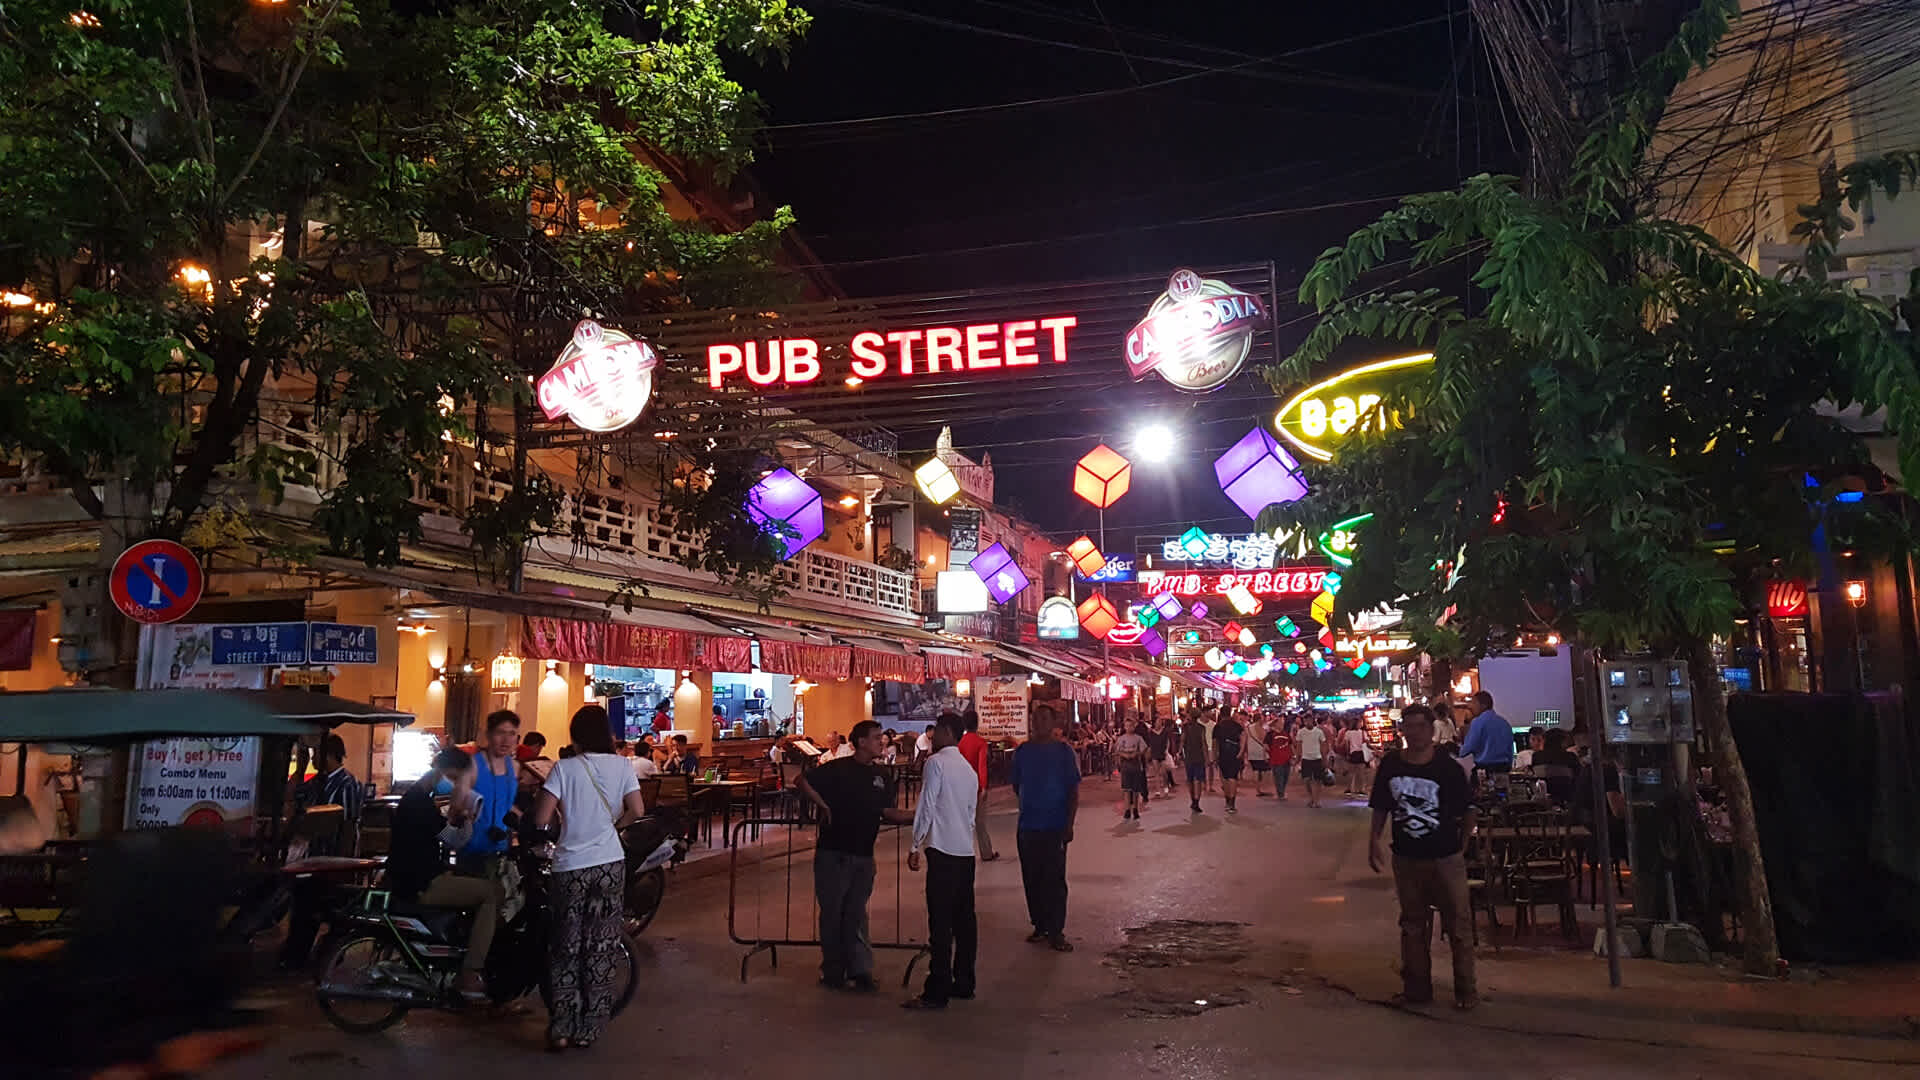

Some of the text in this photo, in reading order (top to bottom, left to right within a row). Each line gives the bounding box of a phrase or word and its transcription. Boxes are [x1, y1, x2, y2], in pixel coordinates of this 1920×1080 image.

[707, 316, 1078, 389] PUB STREET
[1147, 572, 1327, 595] PUB STREET
[1768, 583, 1806, 612] illy
[227, 651, 258, 664] STREET
[146, 748, 168, 763] Buy
[184, 749, 204, 763] get
[217, 750, 243, 761] Free
[160, 767, 227, 779] Combo Menu
[158, 784, 193, 798] 6:00am
[196, 786, 207, 799] to
[210, 786, 250, 800] 11:00am
[140, 803, 160, 817] Only
